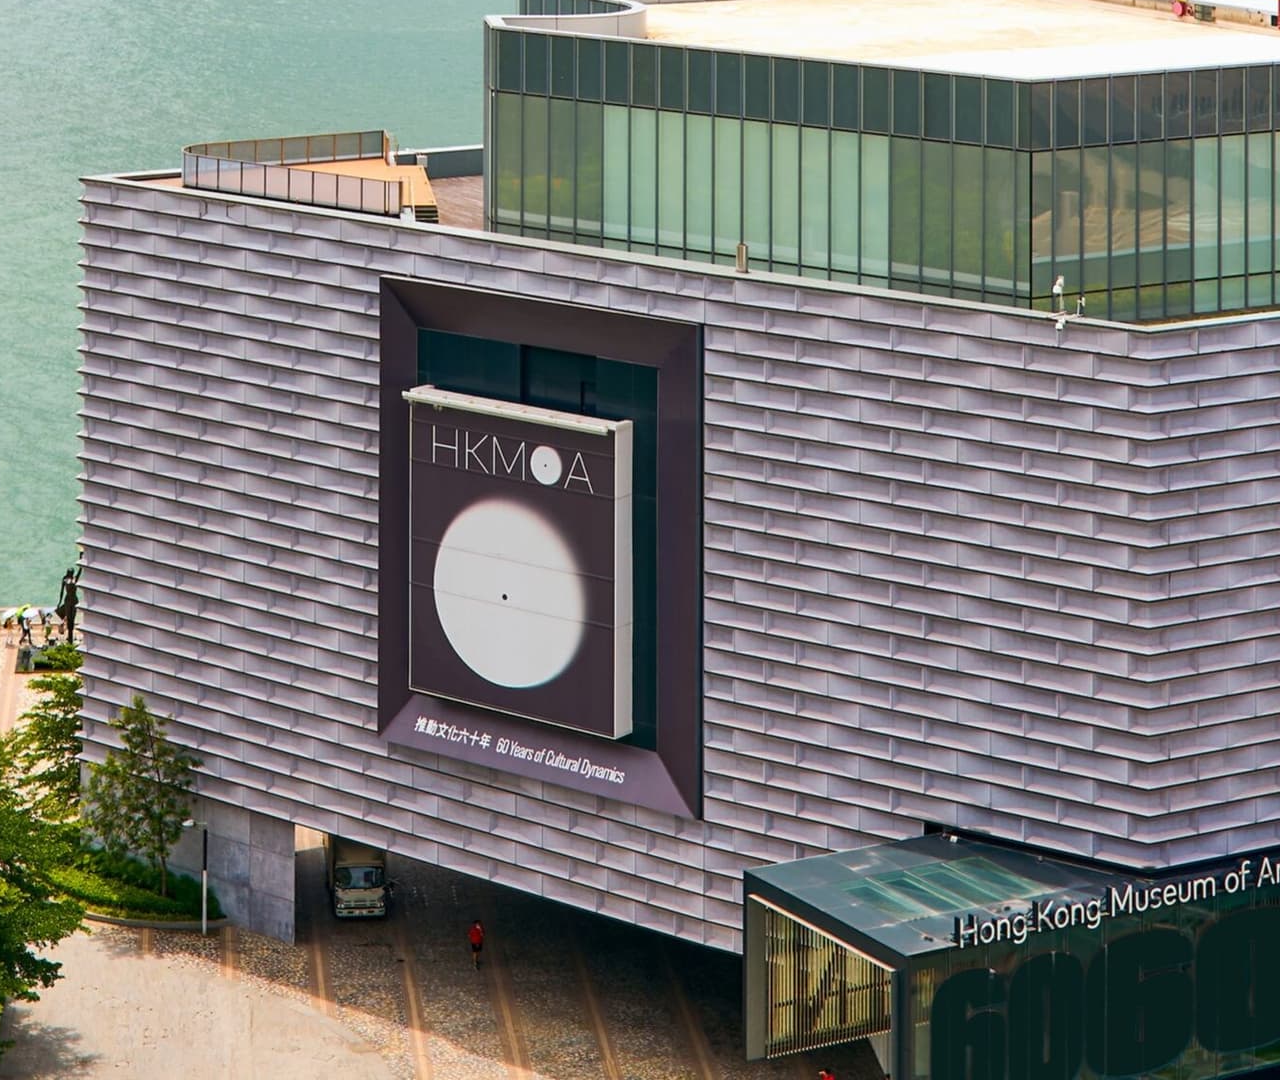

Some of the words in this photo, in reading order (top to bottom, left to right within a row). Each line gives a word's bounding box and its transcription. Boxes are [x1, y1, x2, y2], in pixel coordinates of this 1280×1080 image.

[414, 716, 492, 750] 推動文化六十年
[495, 737, 510, 754] 60
[509, 740, 534, 761] Years
[534, 748, 546, 763] of
[545, 750, 581, 773] Cultural
[579, 759, 626, 785] Dynamics
[958, 914, 1028, 948] Hong
[1036, 899, 1101, 932] Kong
[1110, 876, 1216, 917] Museum
[1223, 859, 1250, 894] of
